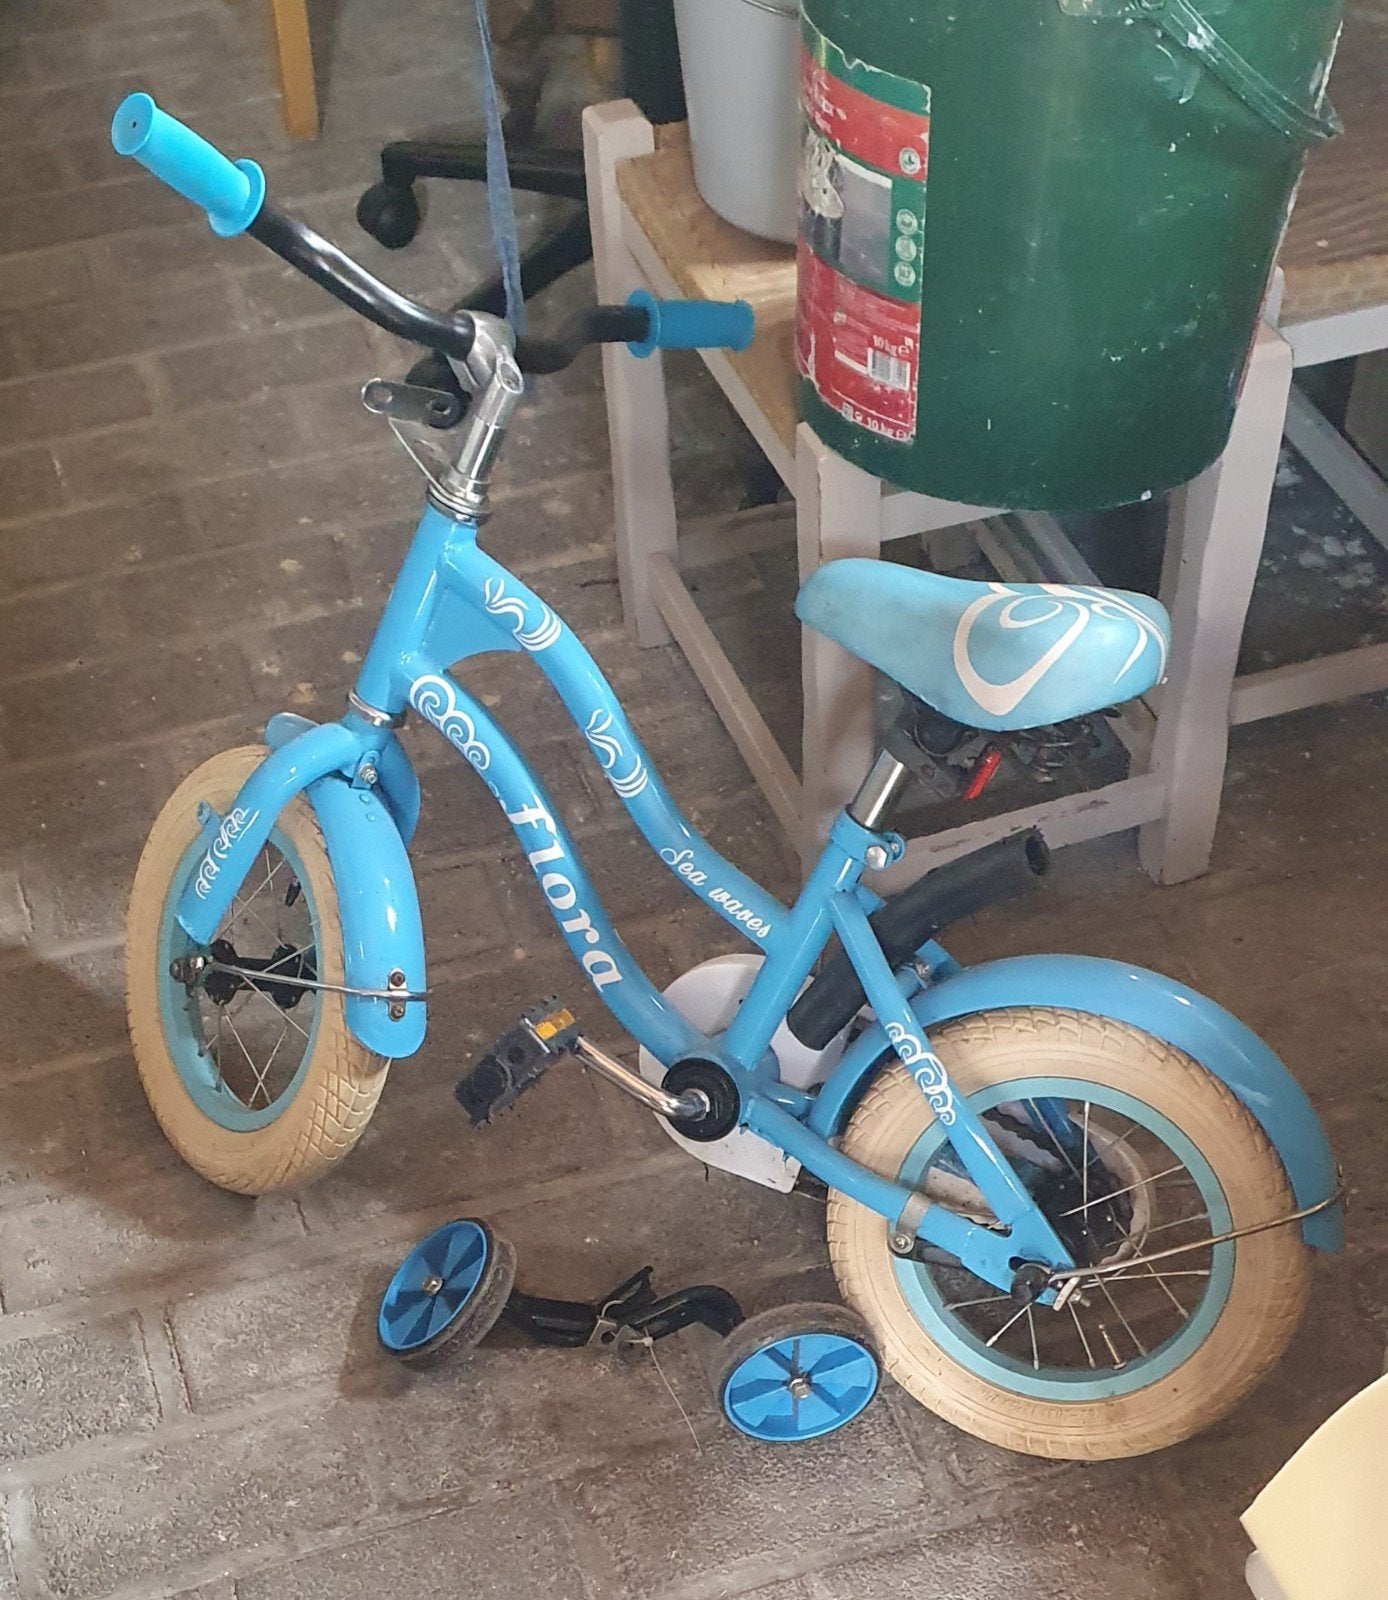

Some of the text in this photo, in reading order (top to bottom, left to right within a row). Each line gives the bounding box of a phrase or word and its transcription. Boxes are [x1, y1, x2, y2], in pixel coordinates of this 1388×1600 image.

[505, 793, 623, 993] flora
[660, 847, 773, 938] Sea waves
